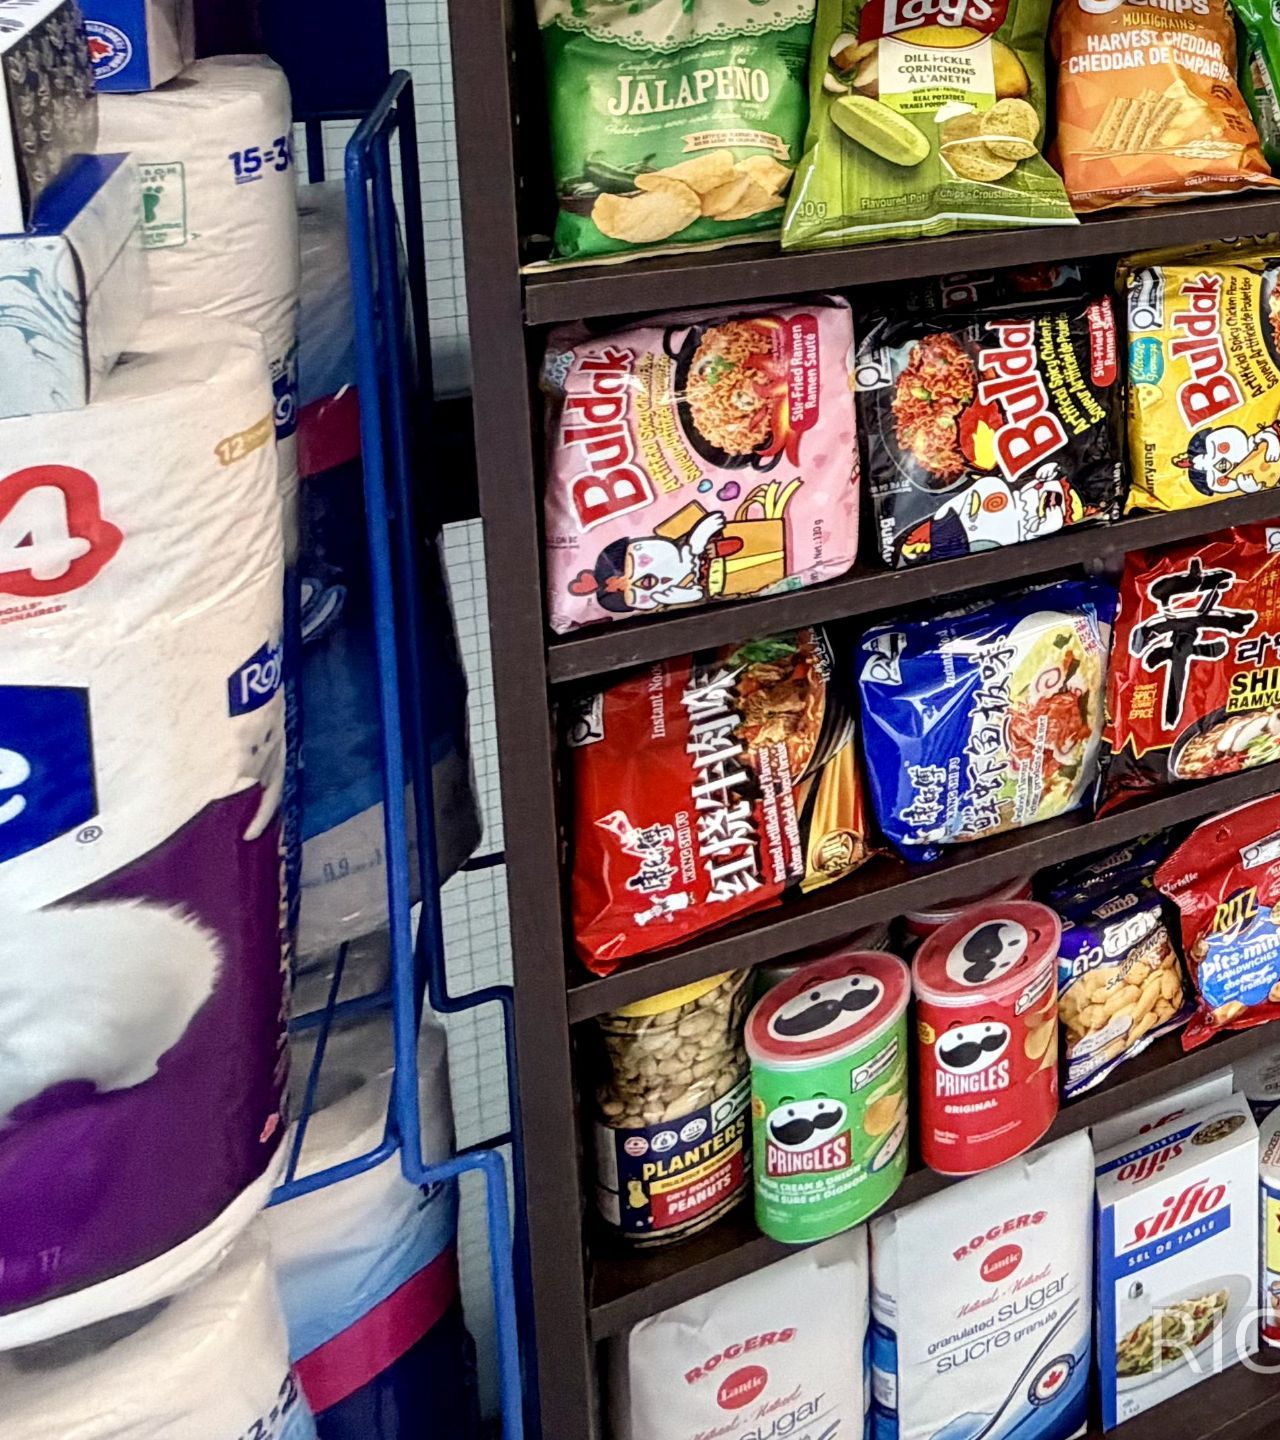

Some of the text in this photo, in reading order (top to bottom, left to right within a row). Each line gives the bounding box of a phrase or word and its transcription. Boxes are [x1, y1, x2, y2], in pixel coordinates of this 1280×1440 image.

[1122, 12, 1197, 32] MULTIGRAINS
[904, 53, 929, 64] DILL
[1069, 48, 1145, 74] CHEDDAR
[1148, 47, 1170, 68] DE
[1087, 30, 1222, 60] HARVEST CHEDDAR
[607, 58, 770, 117] JALAPEÑO
[897, 64, 976, 76] CORNICHONS
[907, 71, 971, 85] À L'ANETH
[803, 332, 818, 410] Ramen Sauté
[1172, 271, 1243, 426] Buldak
[790, 324, 806, 423] Stir-Fried Ramen
[566, 348, 650, 529] Buldak
[1131, 557, 1257, 732] 辛
[1213, 886, 1258, 933] RITZ
[1216, 949, 1279, 982] SANDWICHES
[935, 1062, 1011, 1097] PRINGLES
[943, 1098, 1000, 1116] ORIGINAL
[641, 1116, 746, 1181] PLANTERS
[768, 1137, 849, 1174] PRINGLES
[1116, 1142, 1184, 1185] sifto
[667, 1174, 733, 1216] PEANUTS
[1125, 1178, 1227, 1249] sifto
[952, 1209, 1050, 1263] ROGERS
[1128, 1221, 1217, 1268] SEL DE TABLE
[983, 1253, 1023, 1278] Lantic
[927, 1273, 1071, 1356] granulated sugar
[686, 1326, 798, 1385] ROGERS
[936, 1309, 1059, 1375] sucre granulé
[719, 1375, 765, 1404] Lantic
